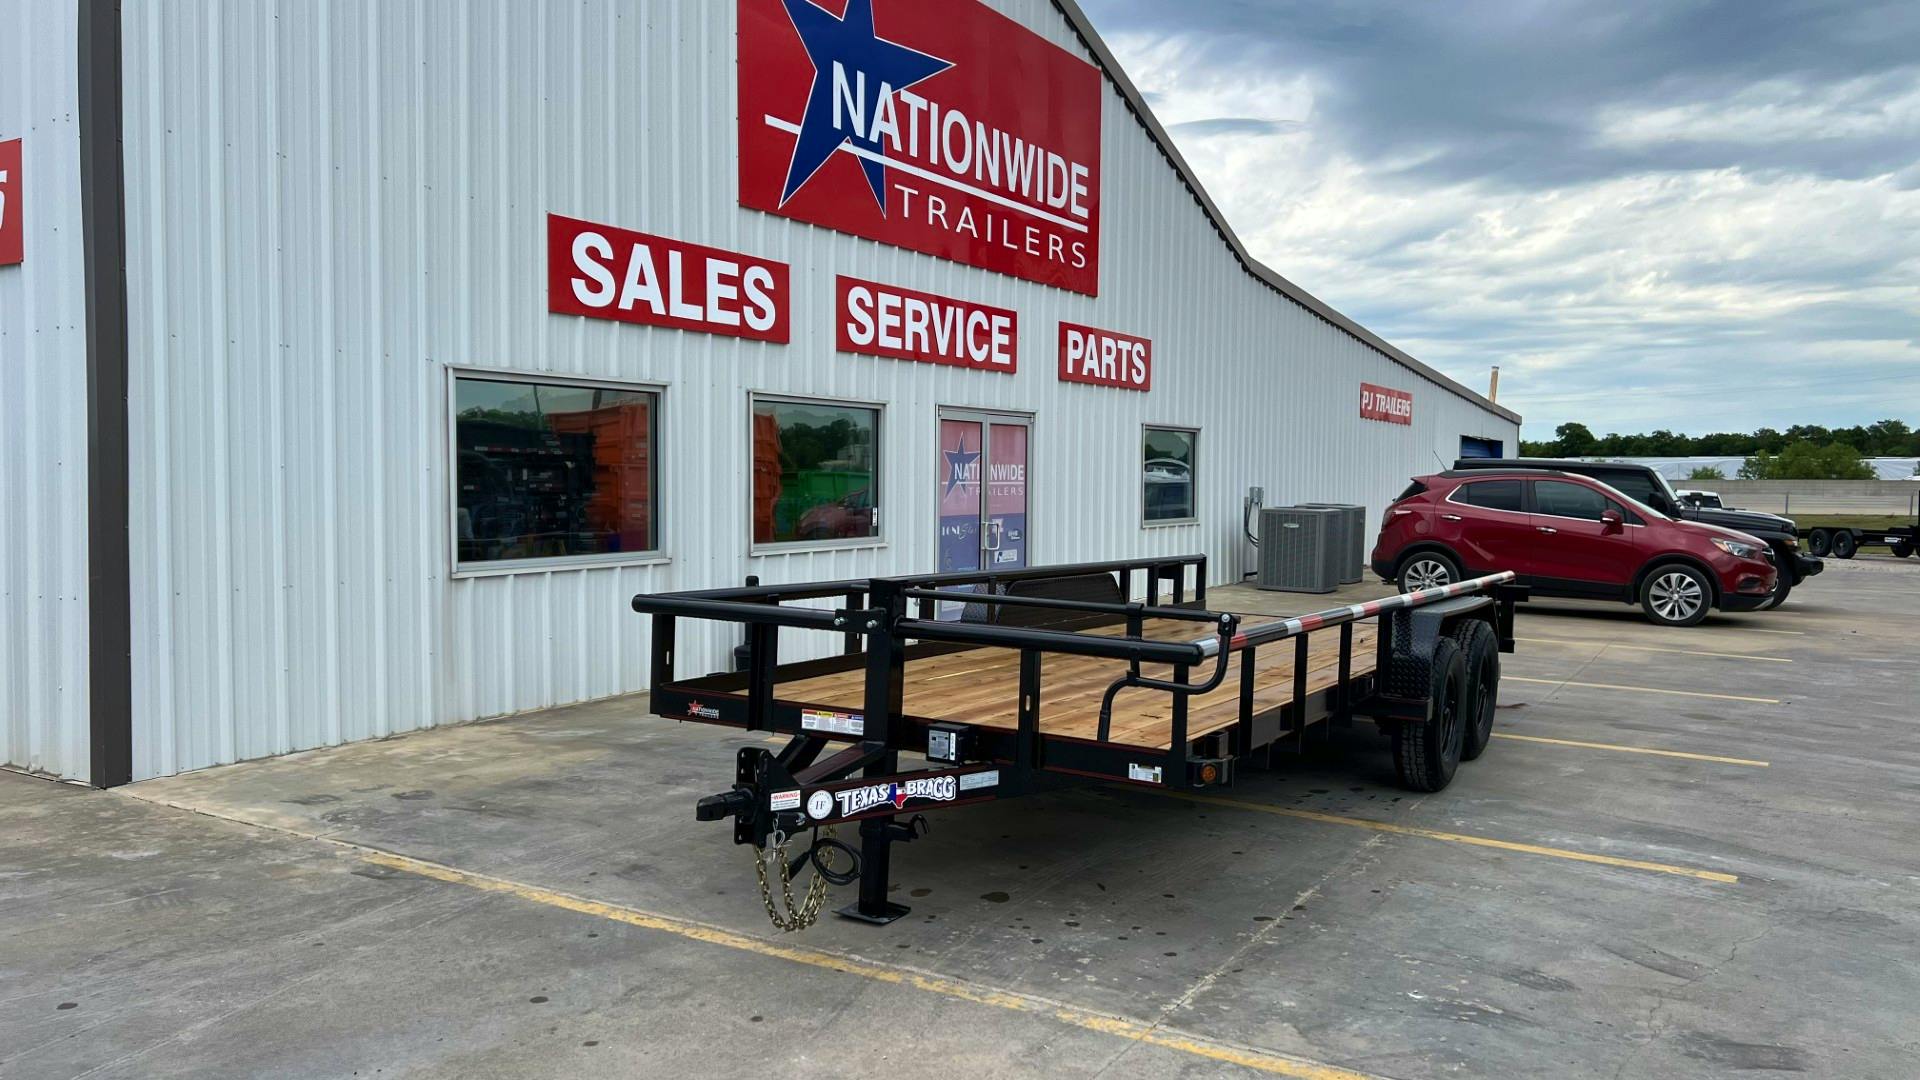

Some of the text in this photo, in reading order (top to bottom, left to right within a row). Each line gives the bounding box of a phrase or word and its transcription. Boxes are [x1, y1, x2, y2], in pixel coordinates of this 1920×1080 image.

[833, 60, 1088, 219] NATIONWIDE
[895, 184, 1086, 268] TRAILERS
[571, 232, 776, 331] SALES
[847, 286, 1011, 364] SERVICE
[1066, 330, 1146, 384] PARTS
[1362, 391, 1411, 416] PJ TRAILERS
[954, 463, 1024, 480] NATINWIDE
[836, 784, 888, 816] TEXAS
[905, 776, 955, 800] BRAGG
